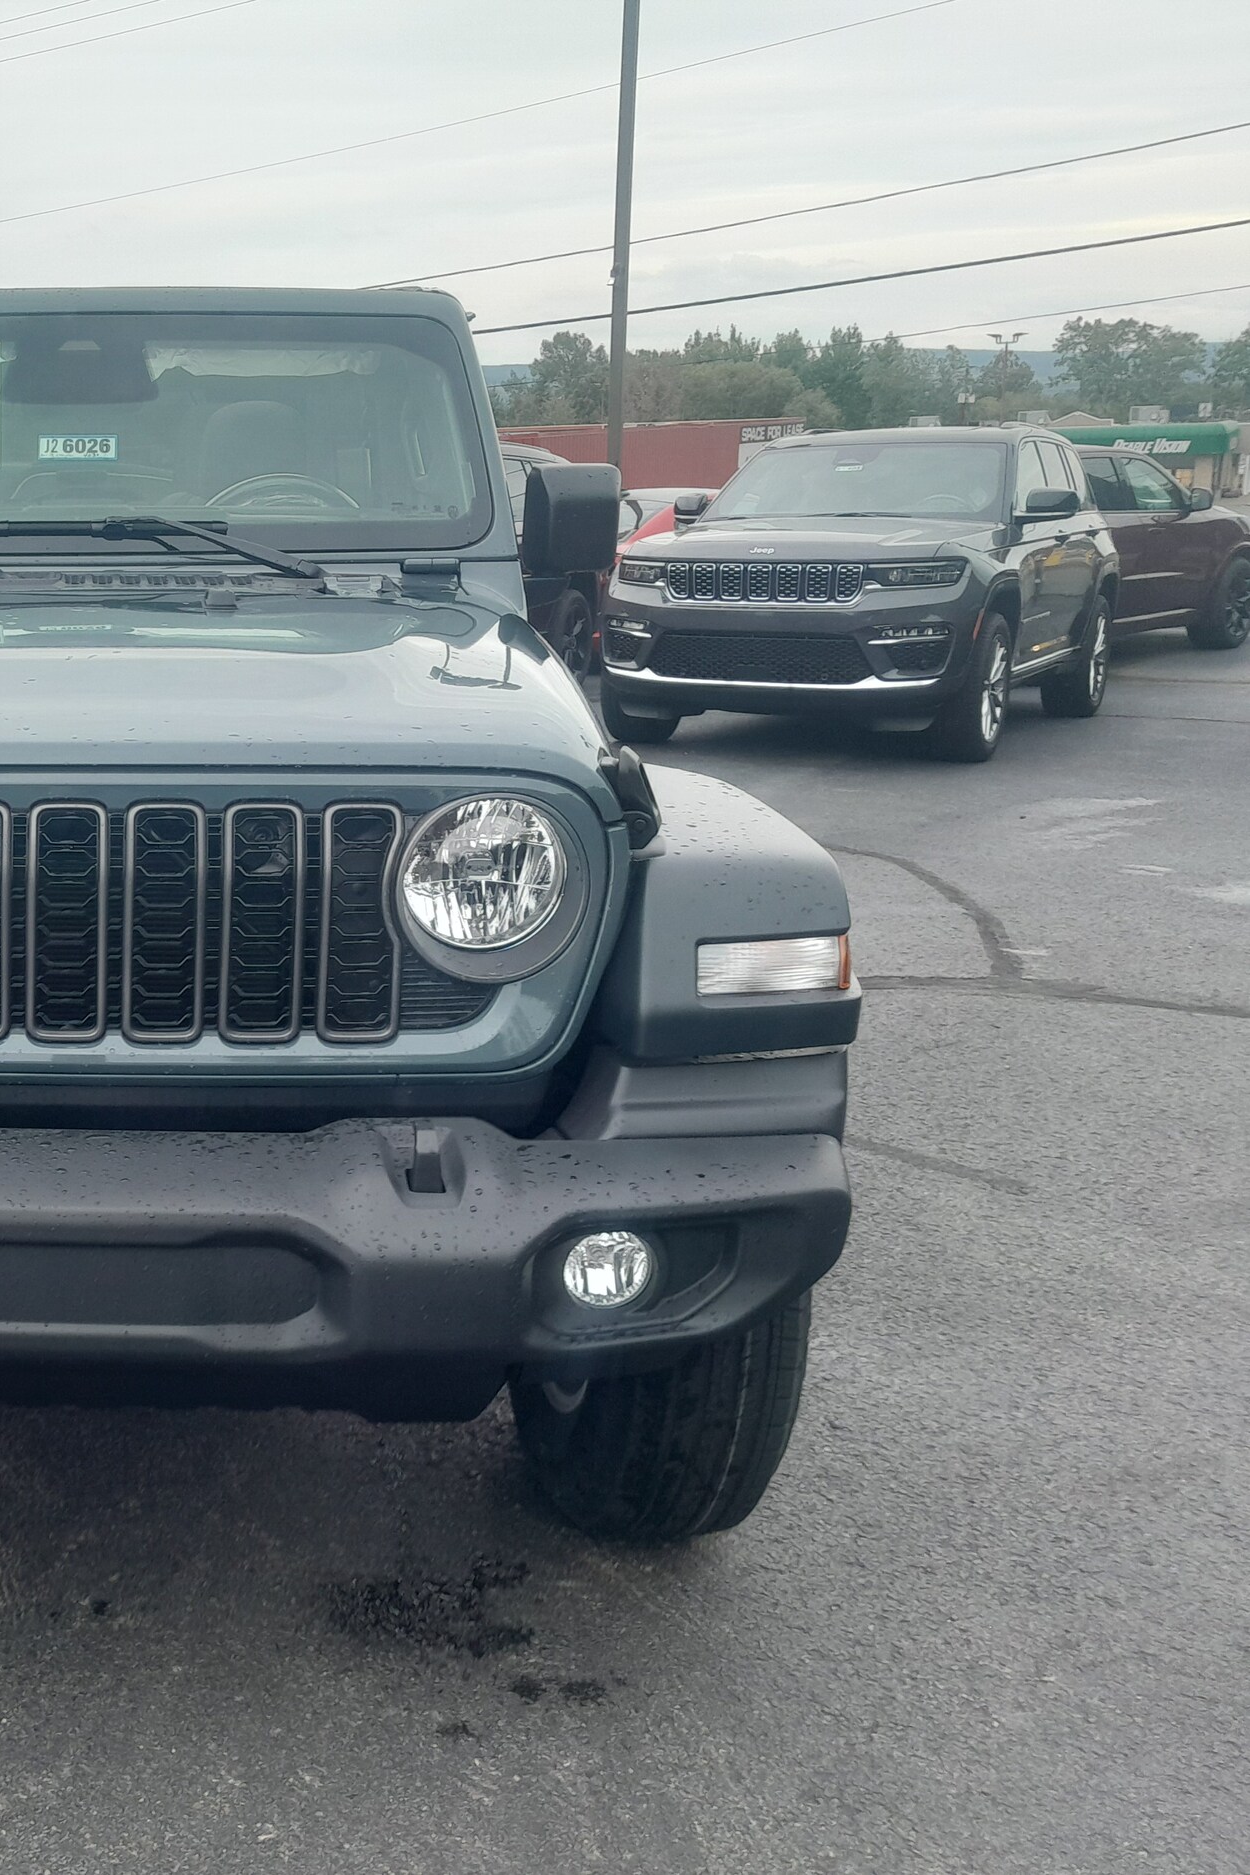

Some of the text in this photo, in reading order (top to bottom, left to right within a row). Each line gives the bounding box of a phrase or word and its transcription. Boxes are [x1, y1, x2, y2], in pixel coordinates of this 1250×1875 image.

[741, 424, 805, 441] SPACE FOR LEASE
[44, 438, 111, 453] J2 6026
